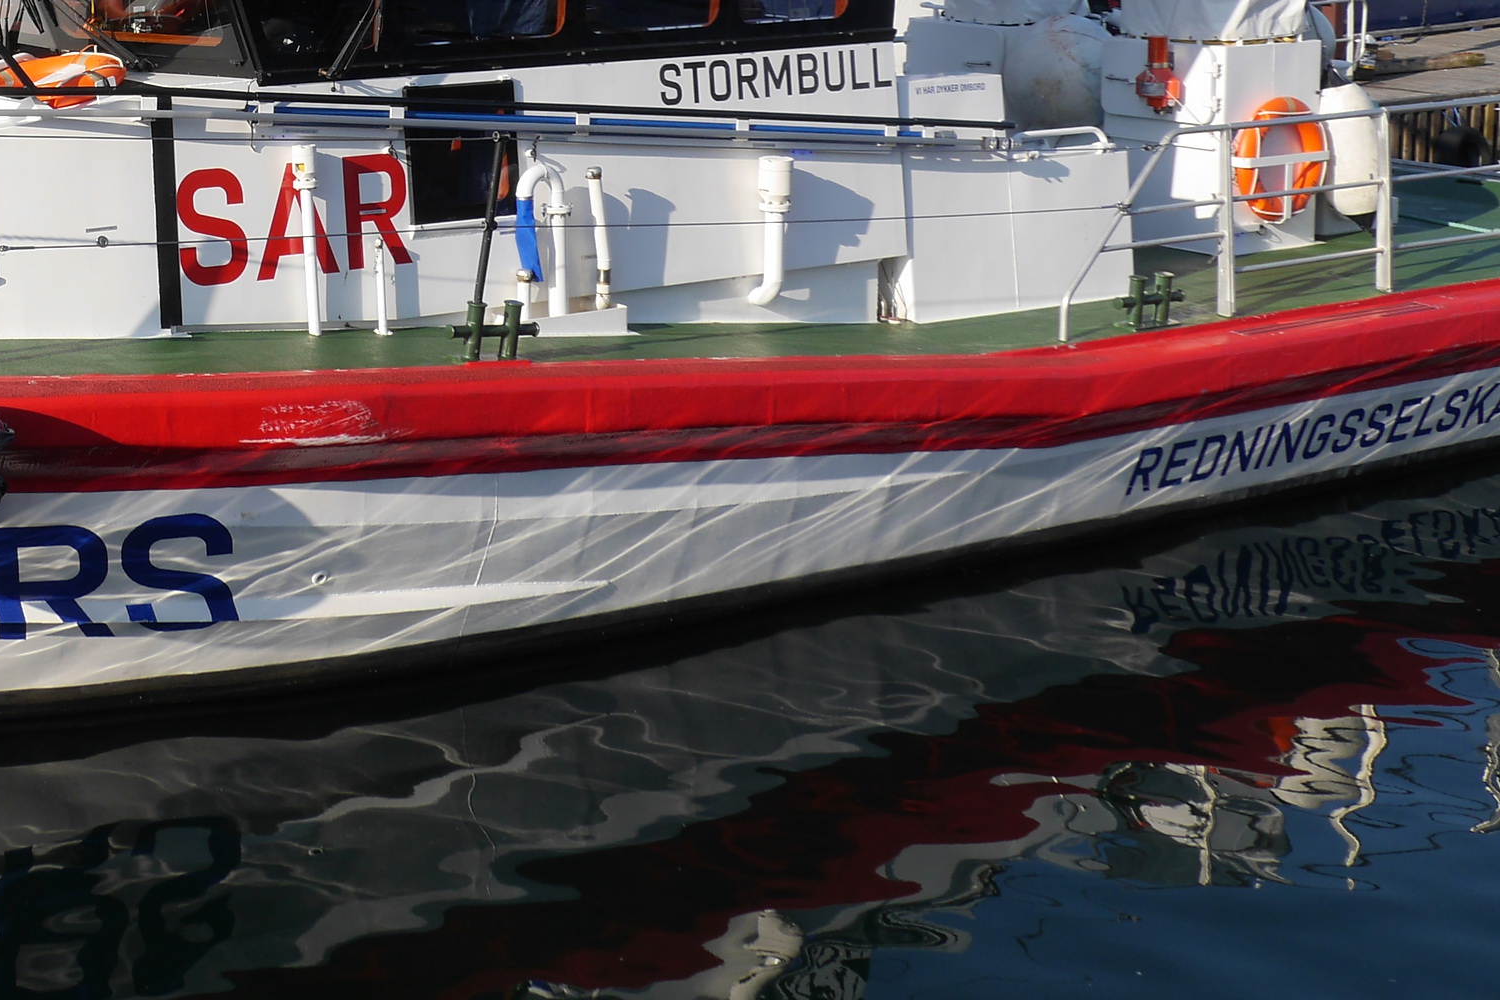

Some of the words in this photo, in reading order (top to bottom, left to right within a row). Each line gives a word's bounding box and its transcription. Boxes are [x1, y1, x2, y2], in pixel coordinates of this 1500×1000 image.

[659, 47, 892, 106] STORMBULL
[915, 87, 922, 95] VI
[923, 86, 935, 94] HAR
[936, 84, 959, 93] DYKKER
[960, 83, 986, 92] OMBORD
[177, 153, 413, 286] SAR
